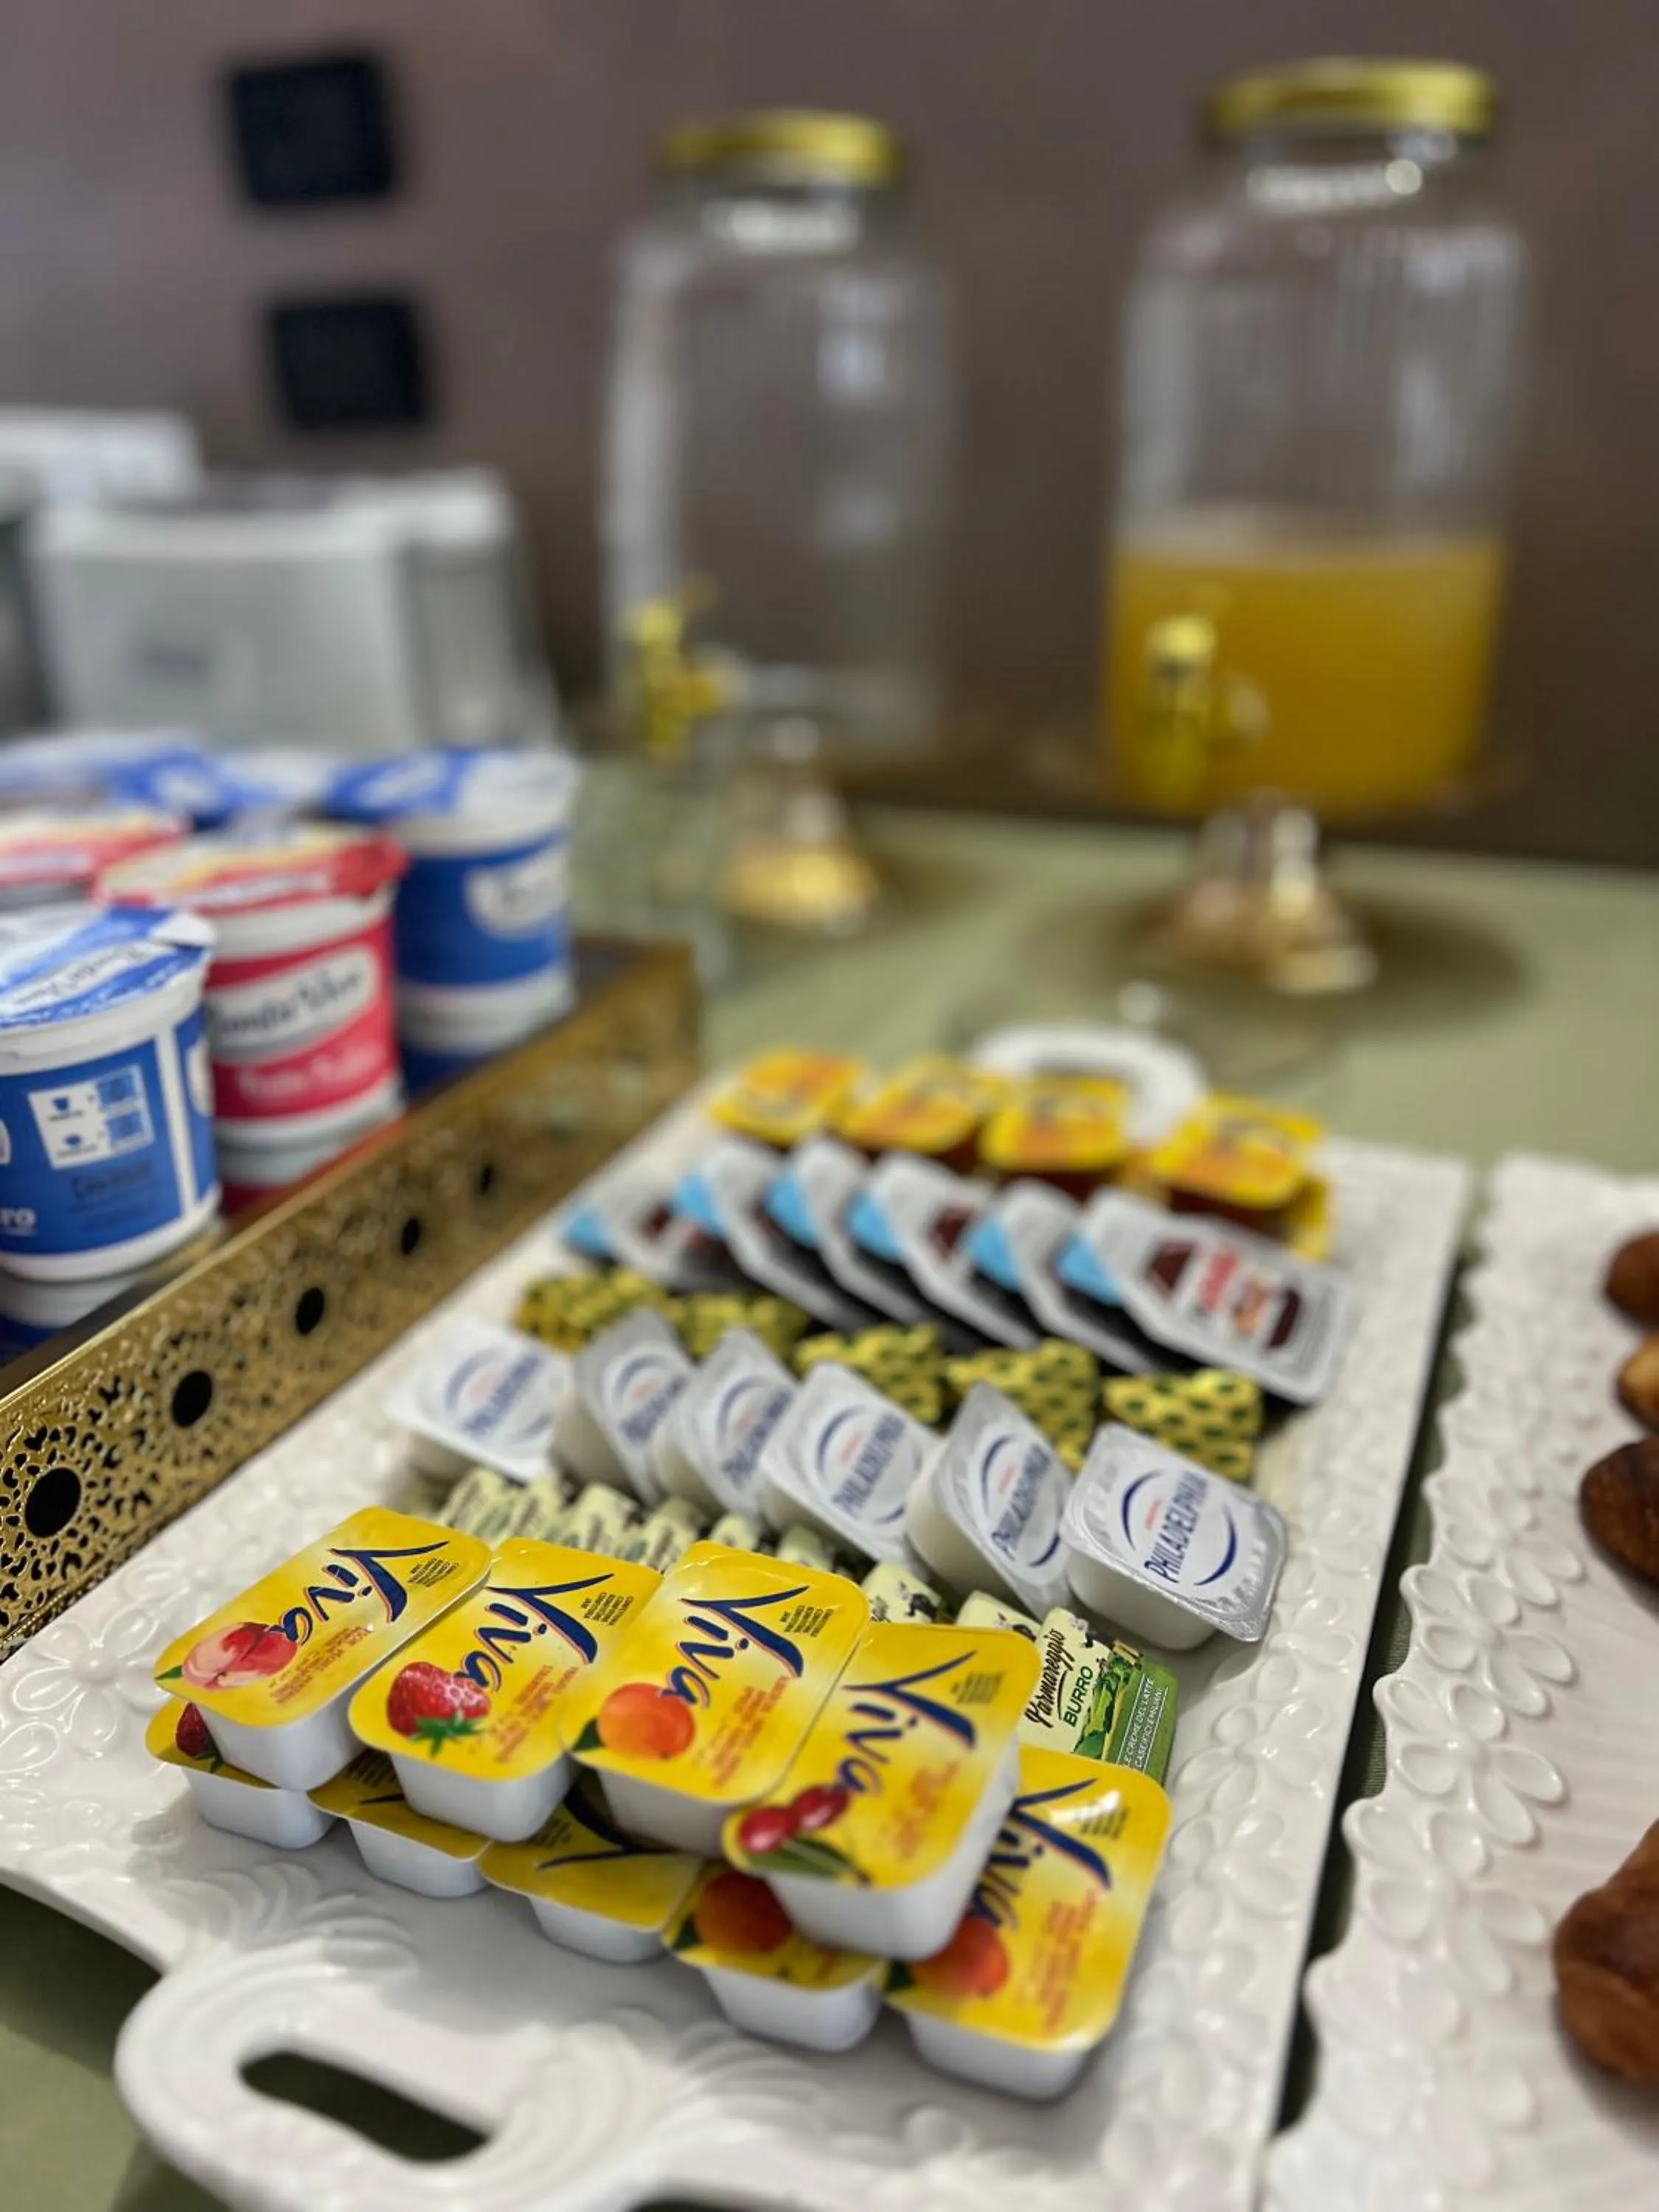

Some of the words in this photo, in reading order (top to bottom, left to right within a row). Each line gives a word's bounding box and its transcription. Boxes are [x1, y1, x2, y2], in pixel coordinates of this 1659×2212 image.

[1144, 1471, 1210, 1584] PHILADELPHIA
[266, 1540, 450, 1646] Viva
[453, 1573, 614, 1692] Viva
[661, 1586, 810, 1709] Viva
[836, 1650, 978, 1795] Viva
[1024, 1628, 1075, 1728] Parmareggio
[1063, 1666, 1093, 1727] BURRO
